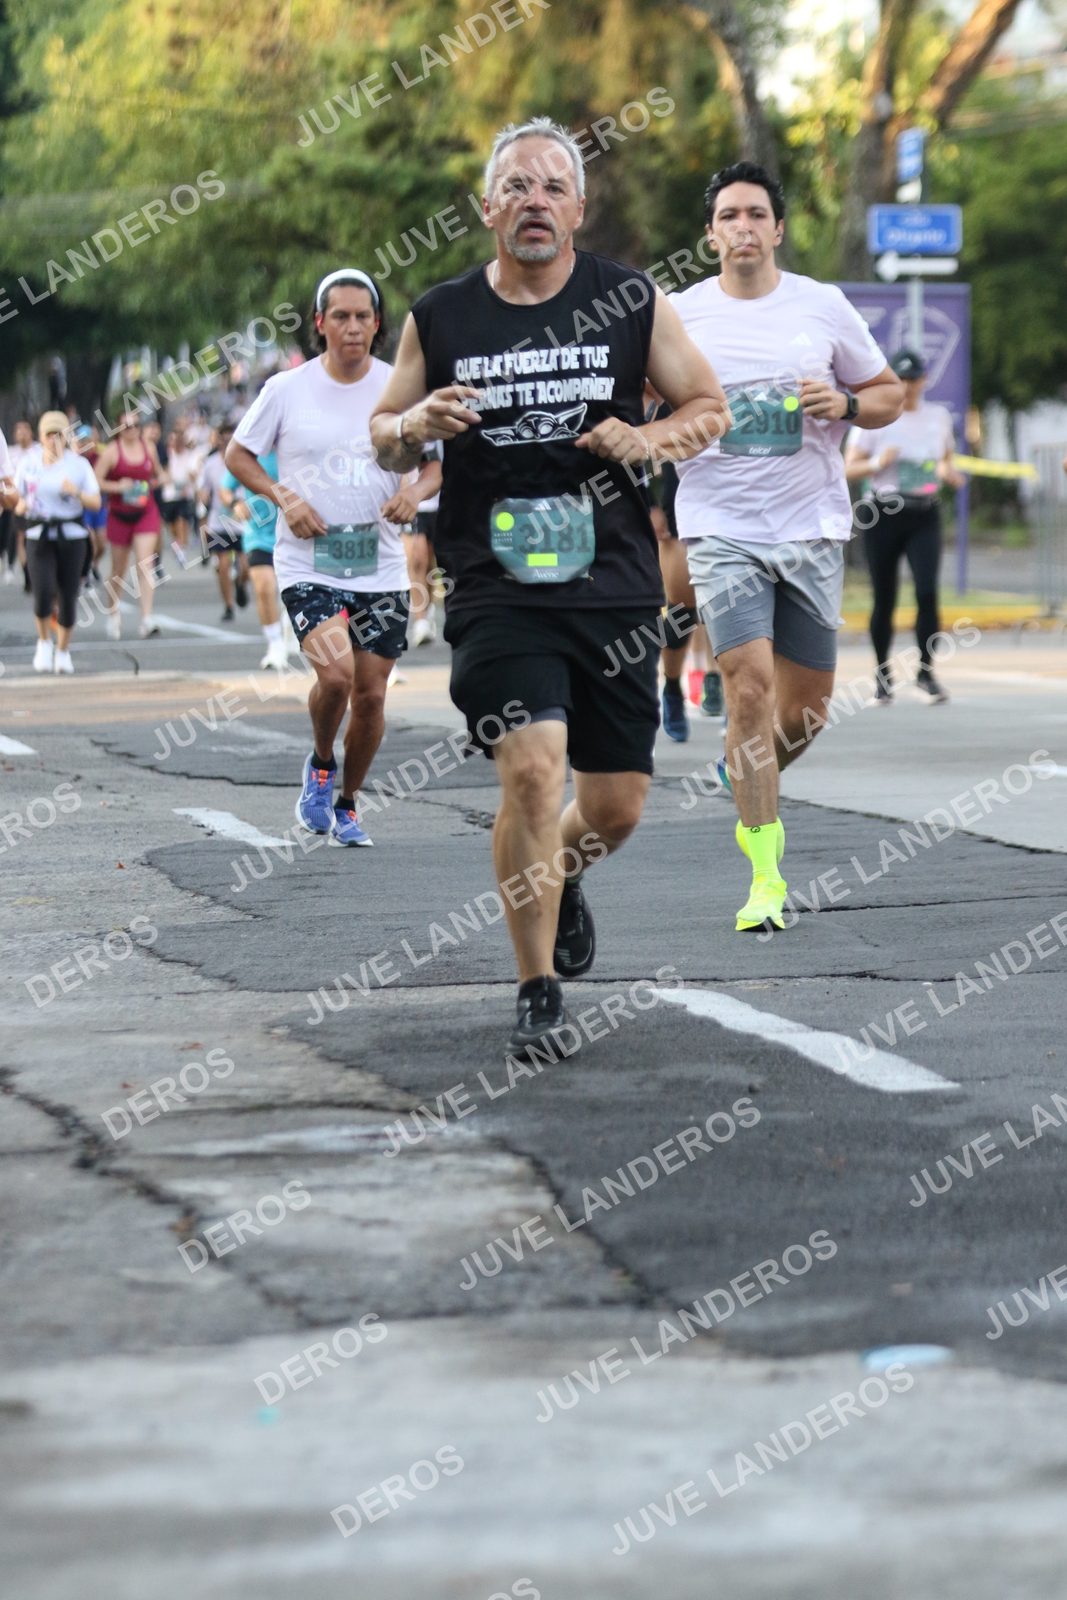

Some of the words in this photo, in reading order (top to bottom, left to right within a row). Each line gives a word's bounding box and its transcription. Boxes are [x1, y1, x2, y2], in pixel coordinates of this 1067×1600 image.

[456, 357, 482, 382] QUE
[483, 355, 503, 378] LA
[504, 348, 559, 376] FUERZA
[561, 347, 580, 370] DE
[581, 346, 610, 369] TUS
[515, 382, 534, 406] TE
[740, 409, 800, 435] 2910
[748, 446, 772, 455] telcel
[332, 537, 377, 560] 3813
[519, 521, 591, 553] 3181
